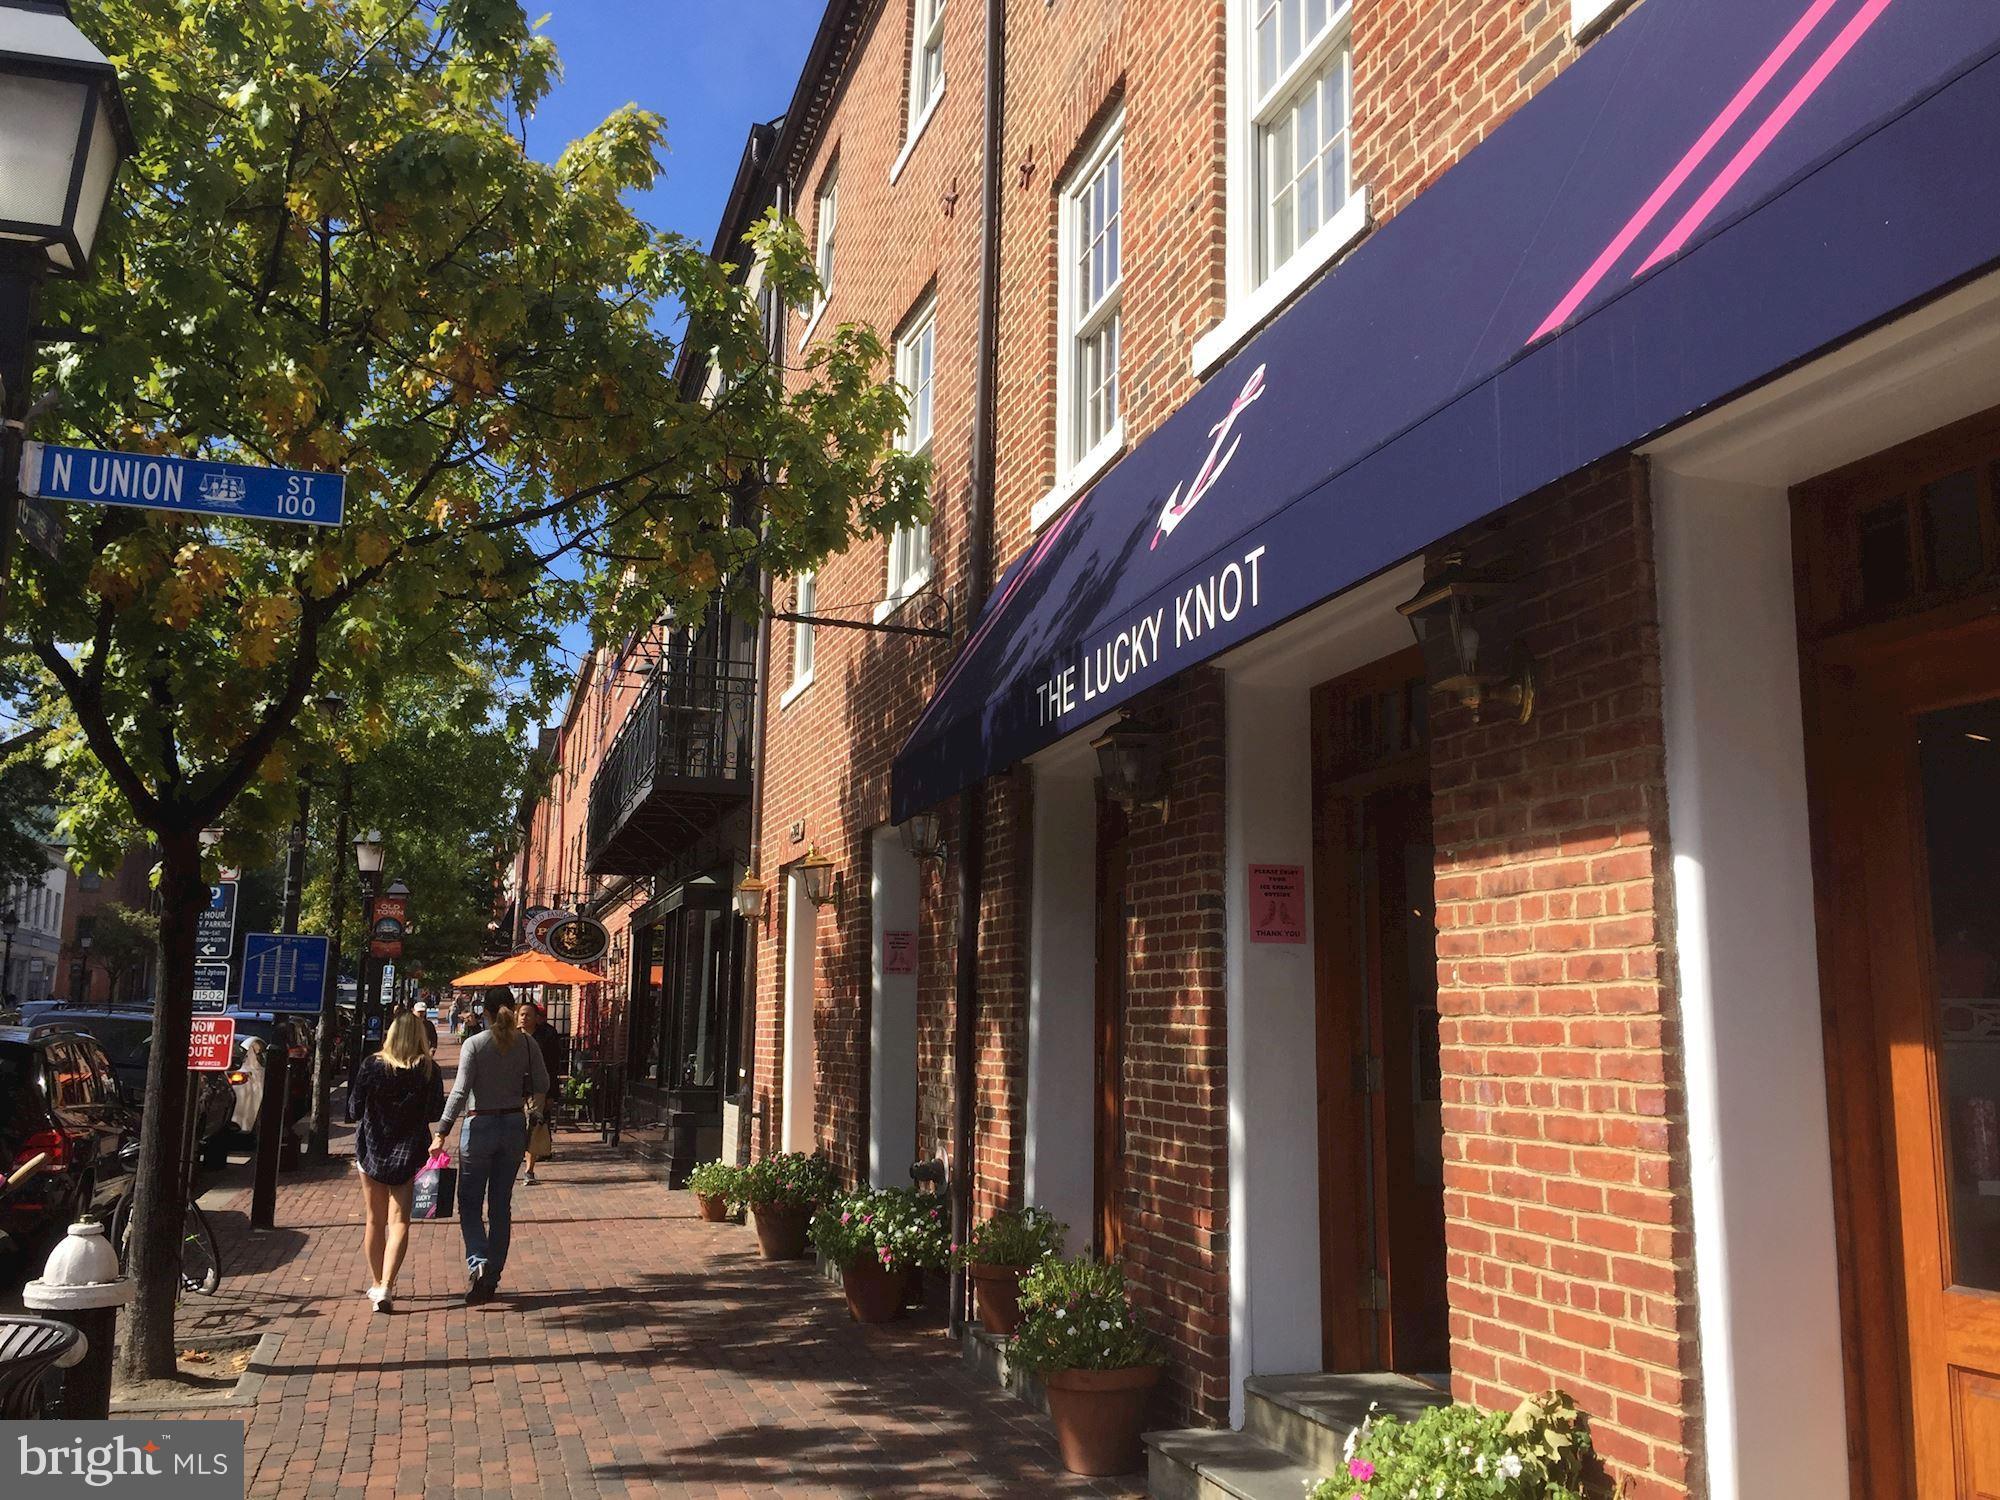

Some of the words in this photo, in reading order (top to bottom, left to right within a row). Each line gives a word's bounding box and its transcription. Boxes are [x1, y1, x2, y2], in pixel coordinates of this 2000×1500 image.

[51, 453, 73, 492] N
[88, 457, 184, 503] UNION
[286, 475, 316, 497] ST
[276, 495, 316, 517] 100
[1036, 665, 1075, 727] THE
[1084, 607, 1164, 702] LUCKY
[1175, 545, 1266, 649] KNOT
[204, 911, 226, 919] HOUR
[204, 920, 232, 928] PARKING
[194, 990, 222, 1000] 11502
[190, 1021, 215, 1032] NOW
[189, 1034, 230, 1044] RGENCY
[187, 1046, 215, 1057] OUTE
